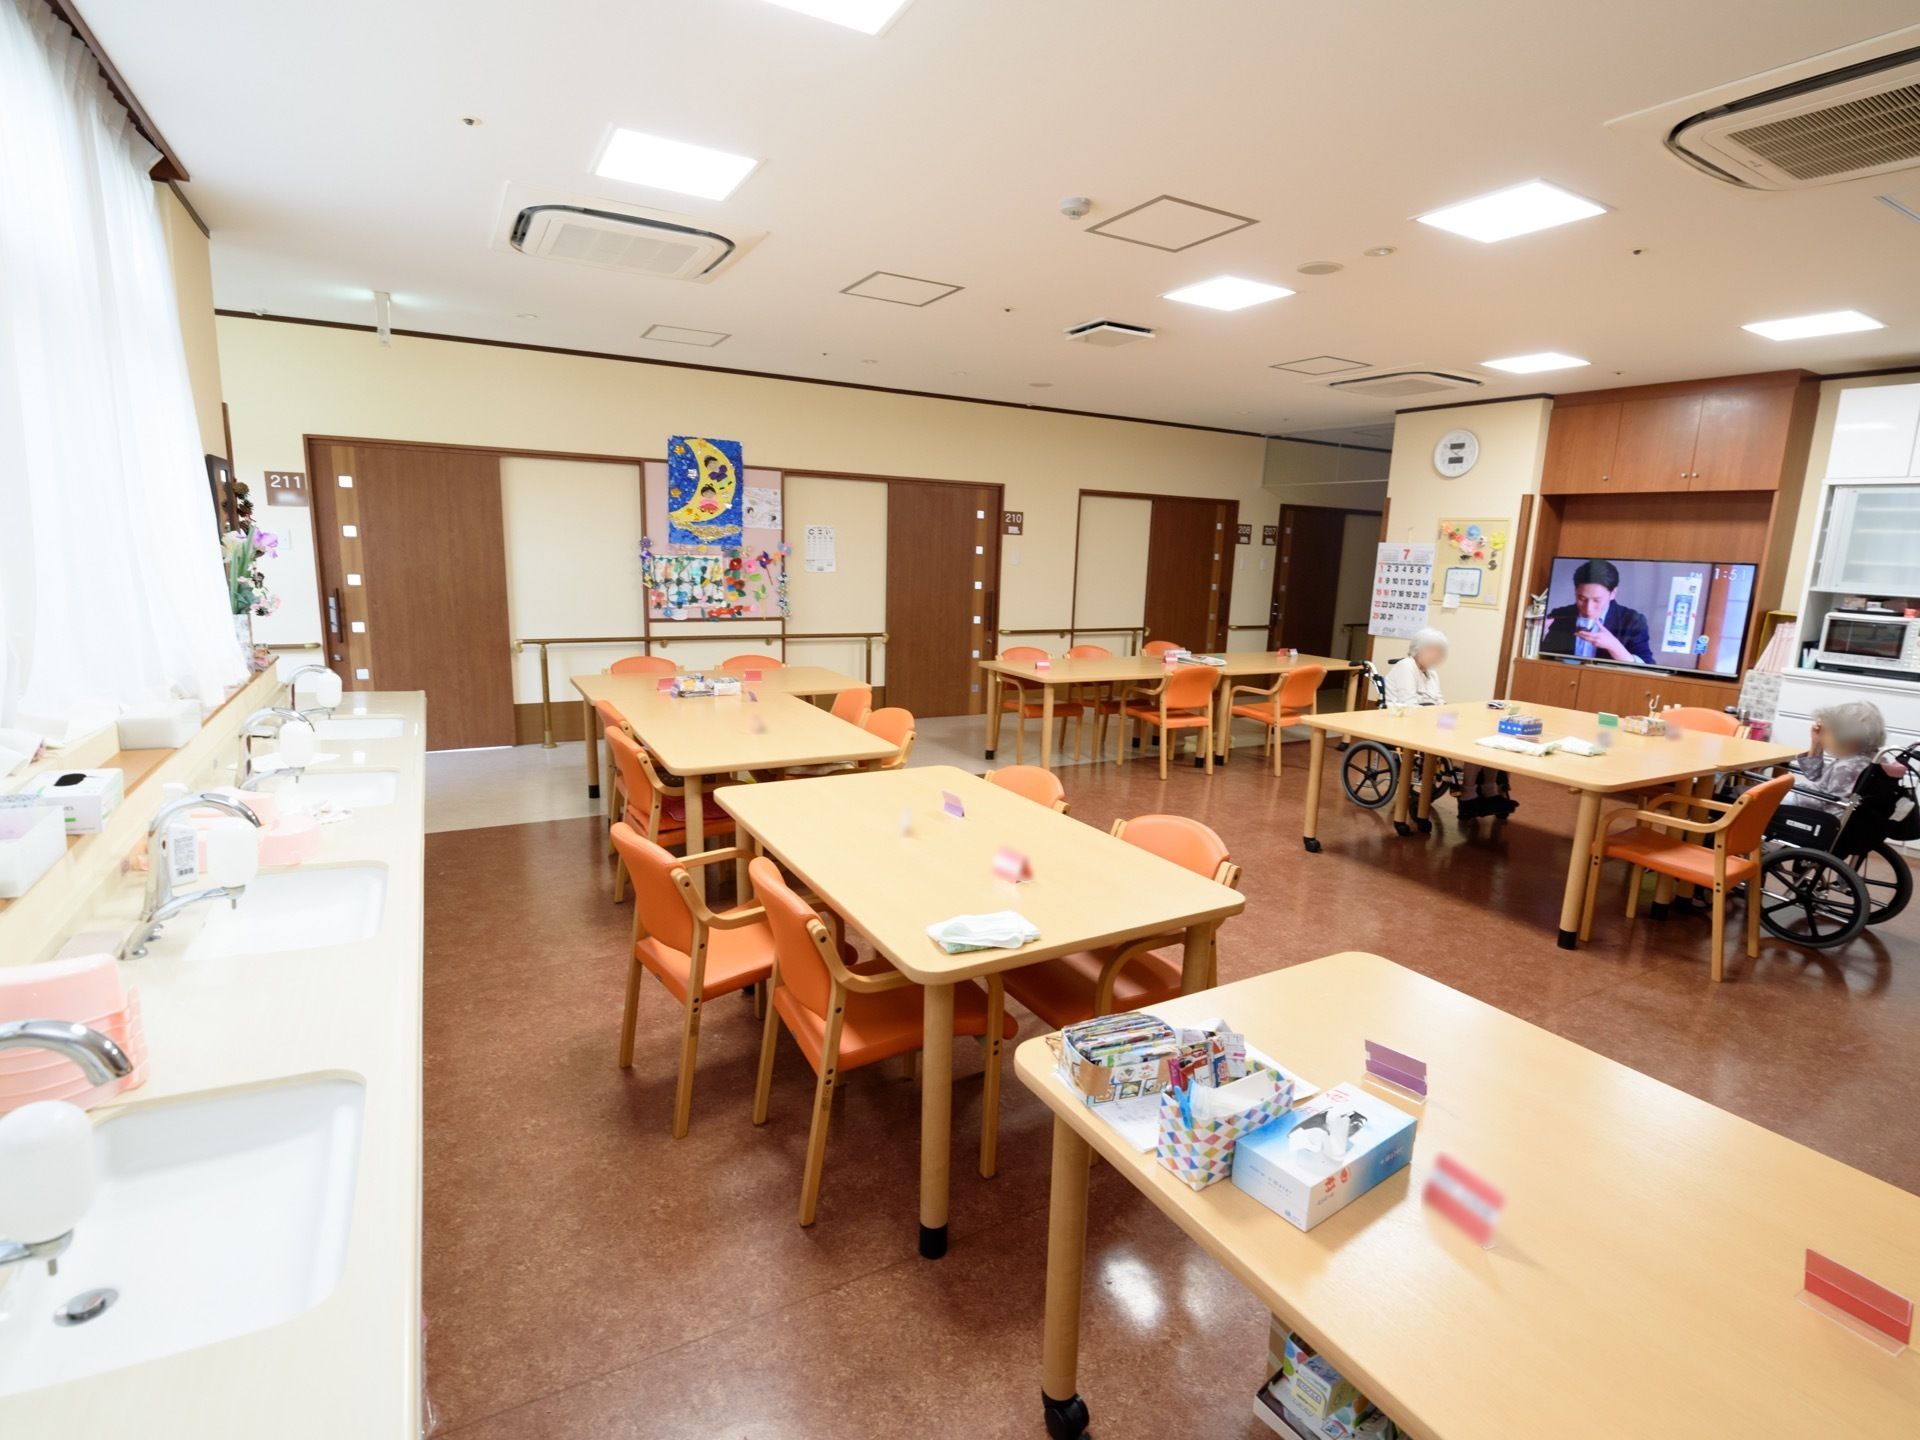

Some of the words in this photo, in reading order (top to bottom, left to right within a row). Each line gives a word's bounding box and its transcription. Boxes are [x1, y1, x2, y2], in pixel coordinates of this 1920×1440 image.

[270, 474, 300, 489] 211
[1005, 513, 1022, 523] 210
[1403, 548, 1411, 560] 7
[1714, 568, 1746, 580] 1:51
